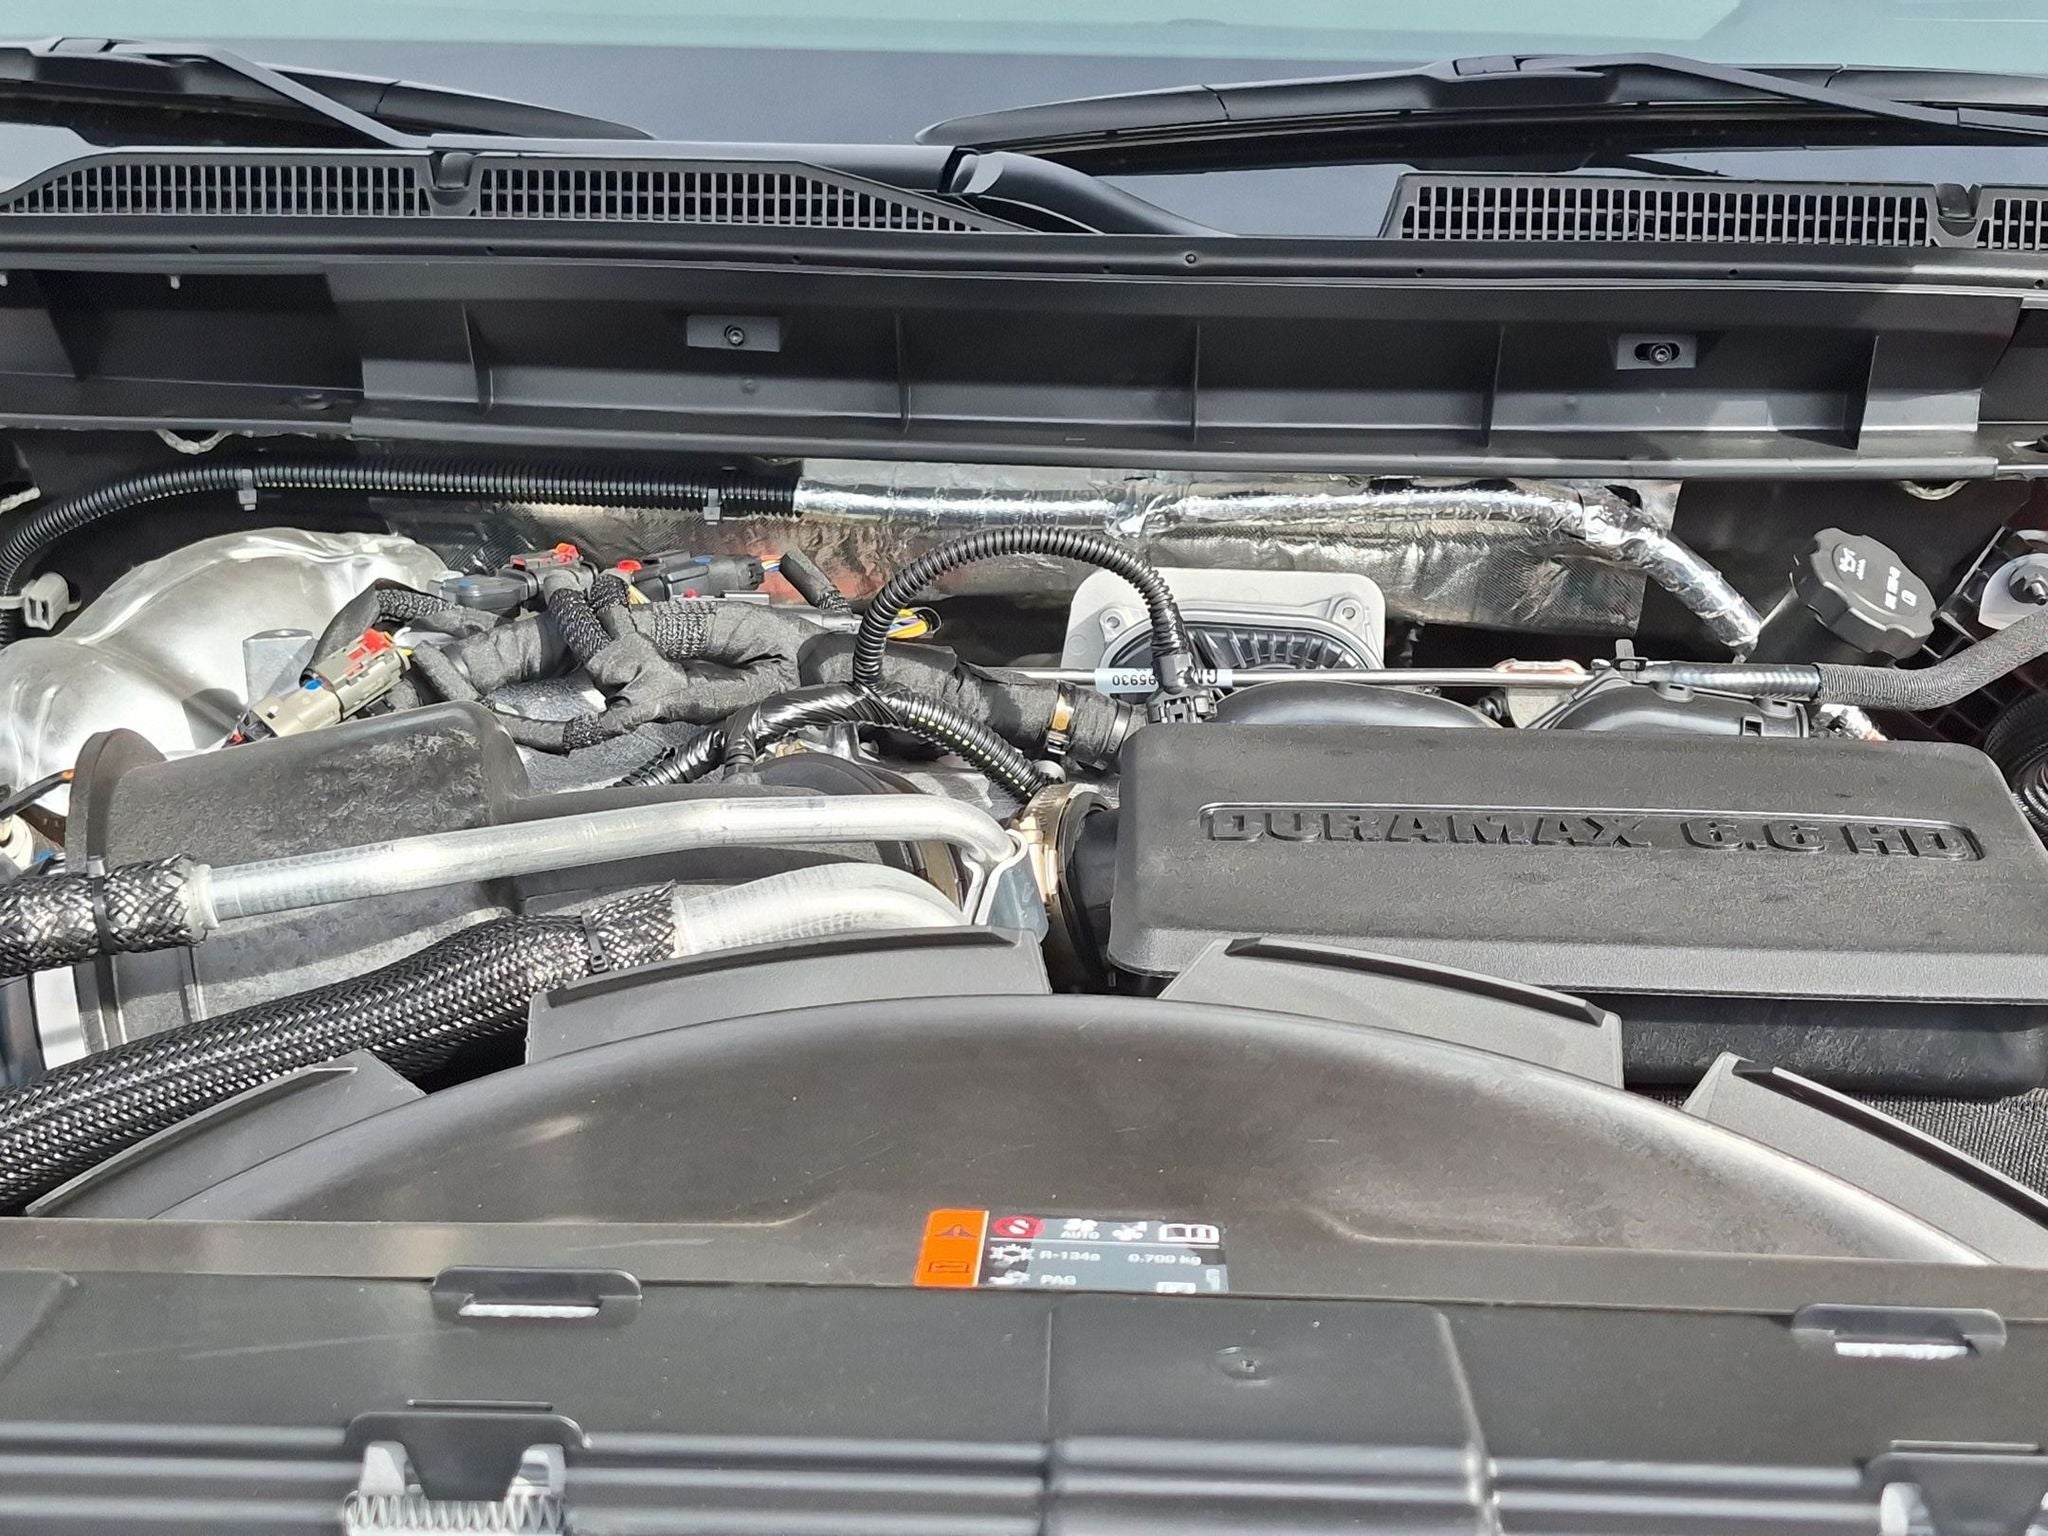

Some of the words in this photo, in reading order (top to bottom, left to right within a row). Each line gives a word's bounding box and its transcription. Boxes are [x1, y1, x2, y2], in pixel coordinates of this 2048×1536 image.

[1200, 811, 1653, 849] DURAMAX
[1680, 818, 1828, 853] 6.6
[1838, 822, 1977, 861] HD
